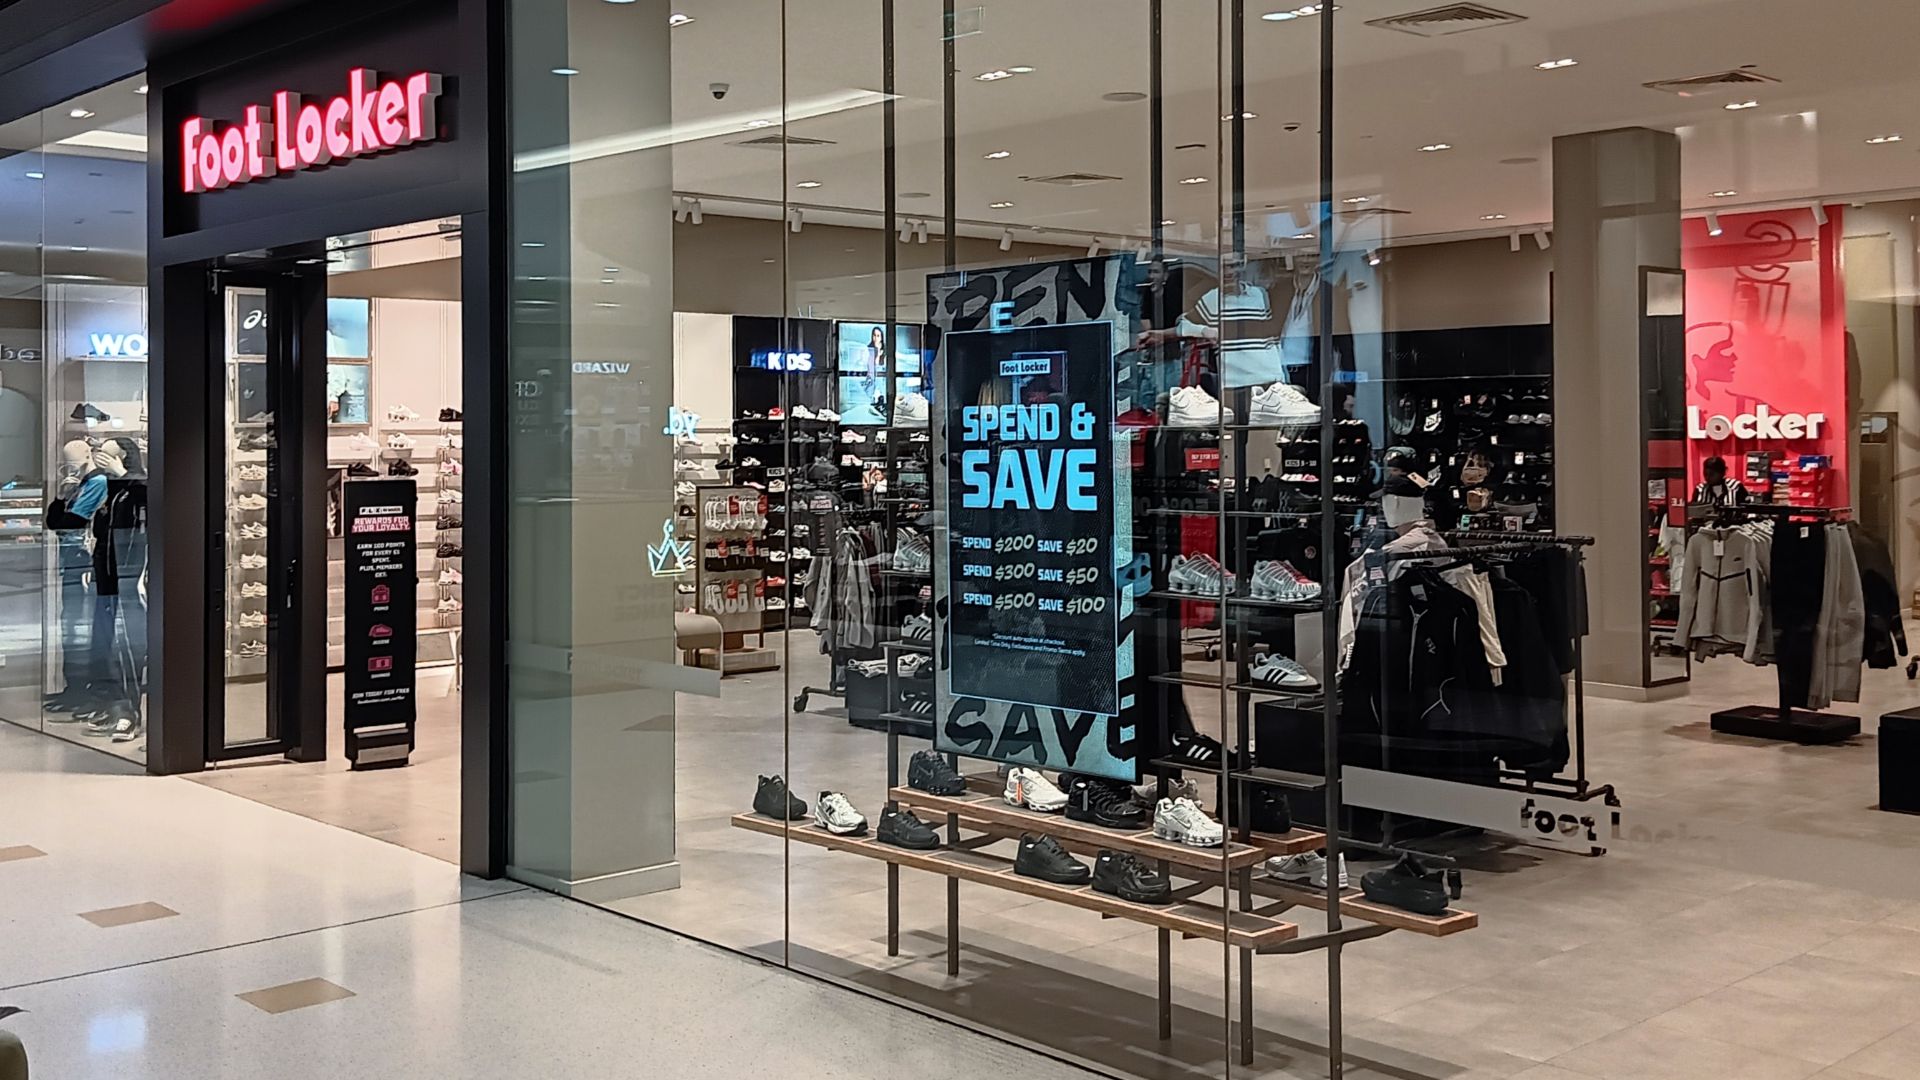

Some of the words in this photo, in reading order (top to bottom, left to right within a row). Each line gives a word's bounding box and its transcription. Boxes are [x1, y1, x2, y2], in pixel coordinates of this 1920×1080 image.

[181, 105, 265, 193] Foot
[275, 68, 433, 171] Locker
[1001, 362, 1019, 375] Foot
[1020, 359, 1048, 372] Locker
[962, 403, 1060, 442] SPEND
[1070, 402, 1096, 441] &
[1687, 404, 1825, 441] Locker
[962, 448, 1097, 511] SAVE
[352, 525, 374, 533] YOUR
[354, 517, 392, 525] REWARDS
[962, 537, 991, 550] SPEND
[994, 535, 1034, 554] $200
[1037, 539, 1063, 553] SAVE
[1066, 538, 1098, 557] $20
[963, 564, 992, 577] SPEND
[994, 563, 1035, 582] $300
[1037, 568, 1063, 582] SAVE
[1066, 567, 1099, 587] $50
[963, 592, 992, 606] SPEND
[994, 592, 1035, 611] $500
[1038, 598, 1064, 612] SAVE
[1066, 597, 1105, 616] $100
